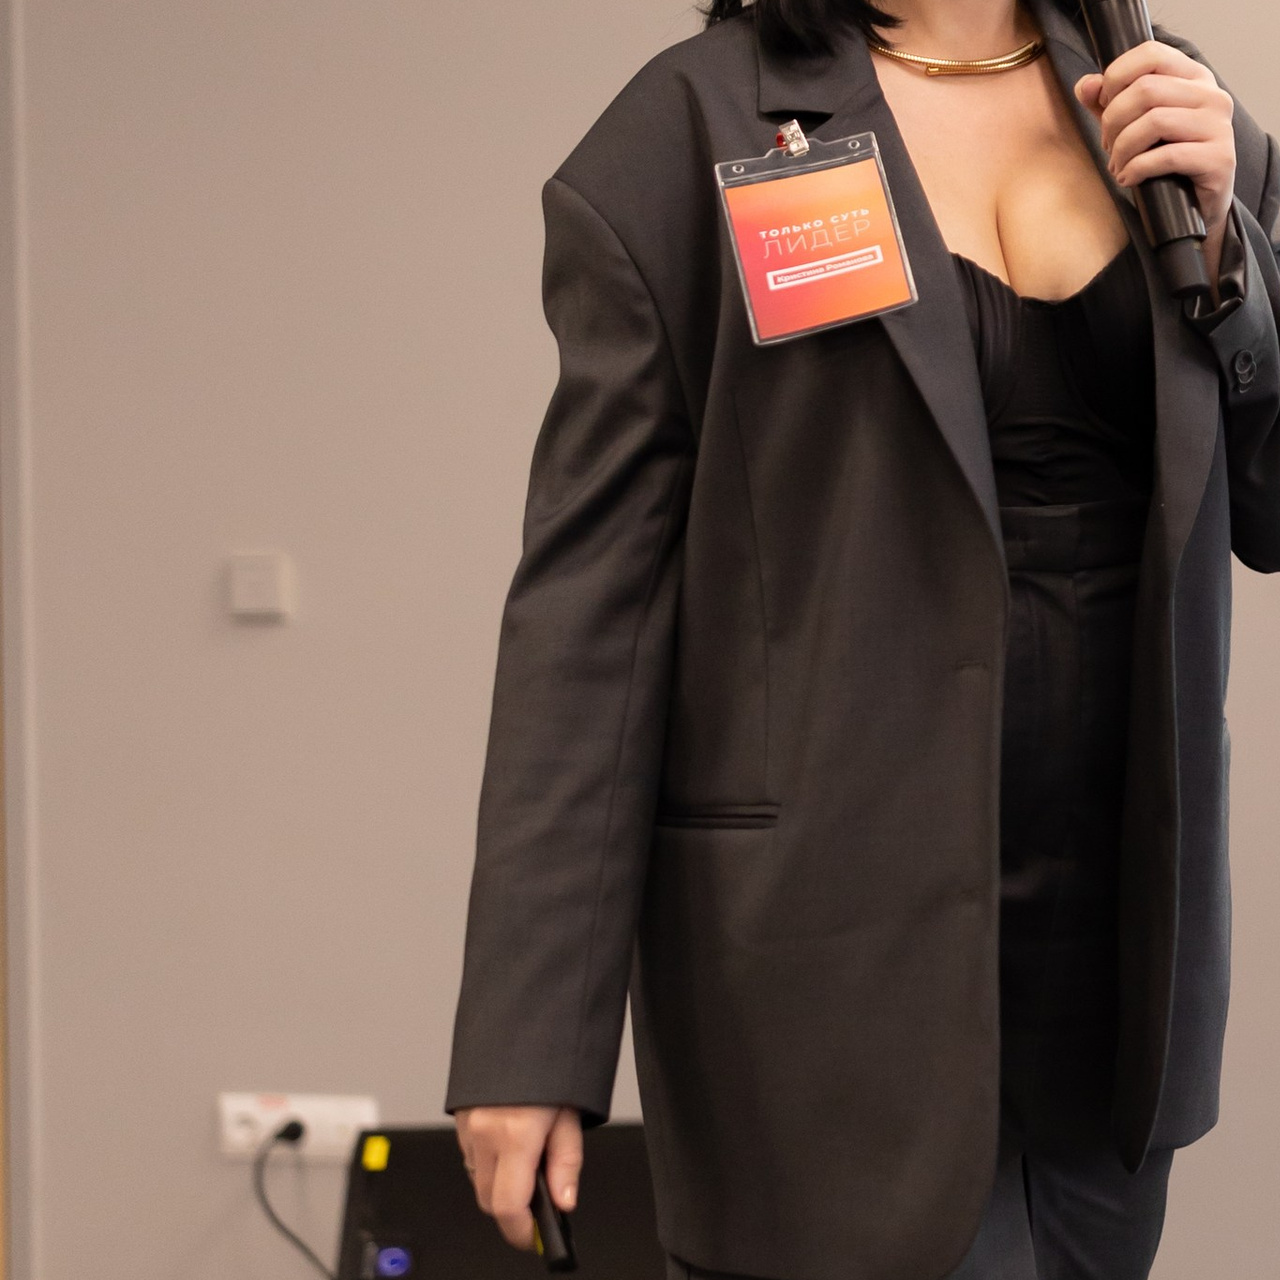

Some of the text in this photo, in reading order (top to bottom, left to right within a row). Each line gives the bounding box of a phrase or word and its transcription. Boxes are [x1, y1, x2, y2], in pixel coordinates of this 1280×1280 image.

[759, 208, 870, 239] ТОЛЬКО СУТЬ
[763, 219, 871, 259] ЛИДЕР
